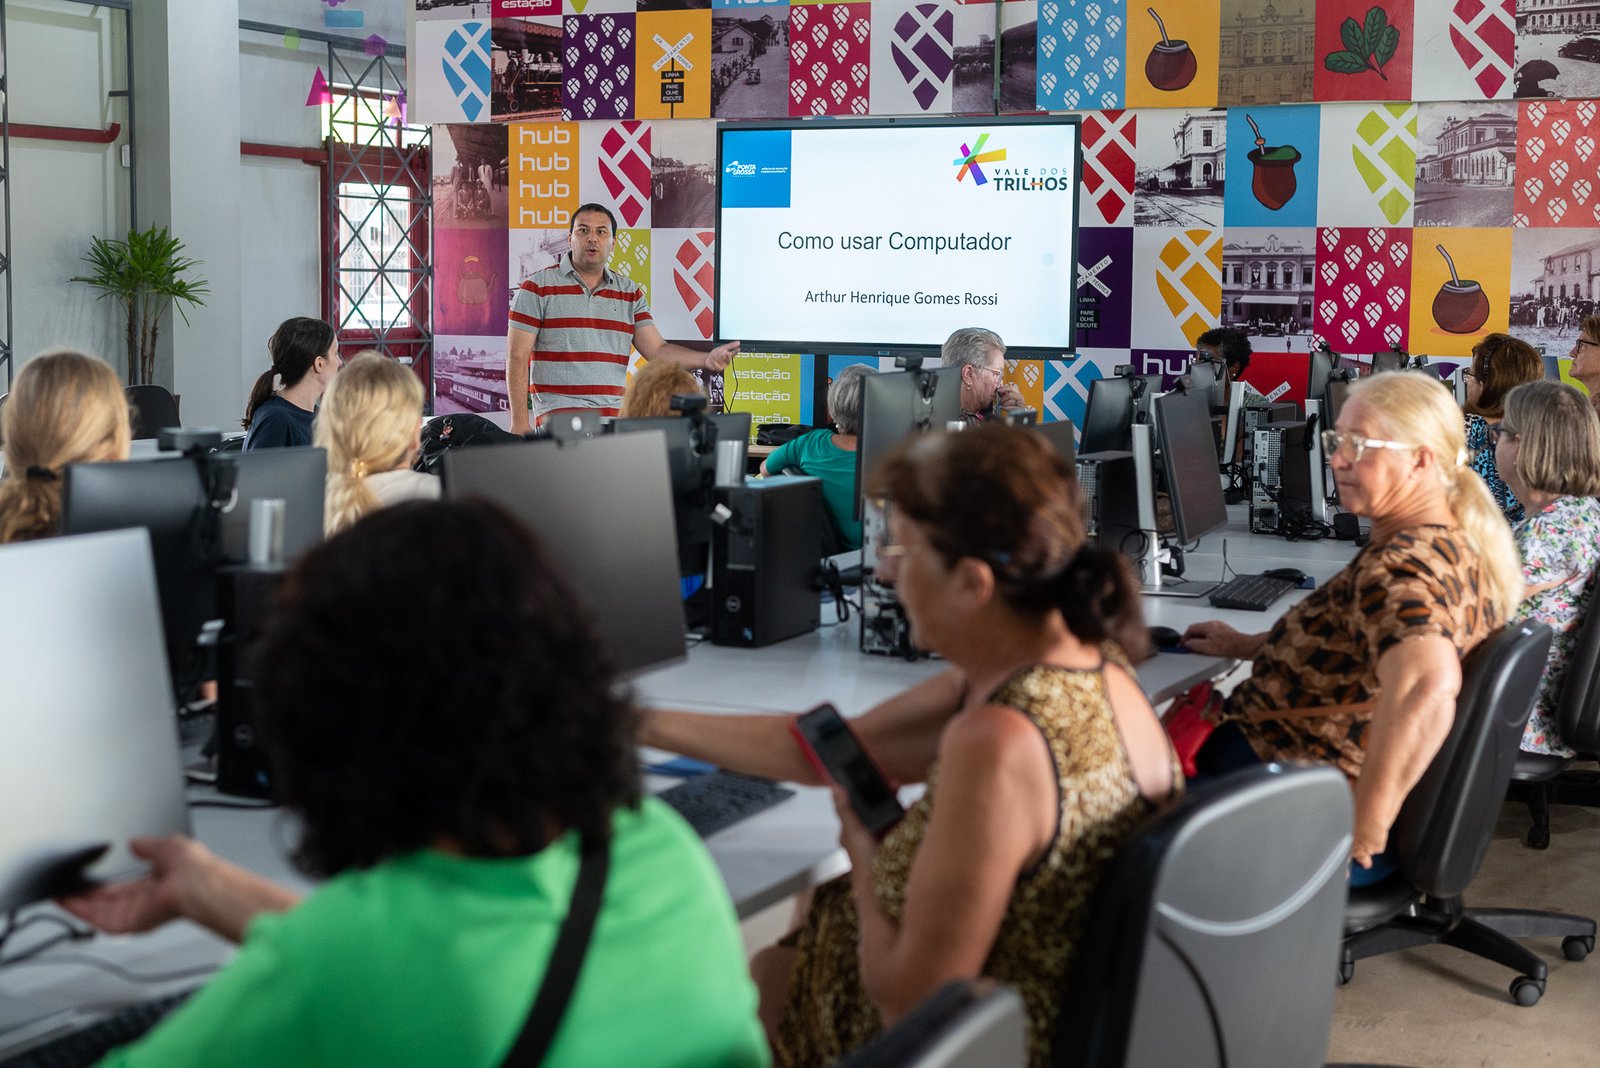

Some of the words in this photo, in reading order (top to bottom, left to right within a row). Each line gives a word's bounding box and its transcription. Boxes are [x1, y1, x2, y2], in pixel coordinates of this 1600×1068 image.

[656, 35, 691, 67] CRUZAMENTO
[519, 125, 570, 144] hub
[519, 152, 570, 171] hub
[519, 179, 570, 198] hub
[993, 177, 1068, 191] TRILHOS
[519, 205, 570, 225] hub
[778, 231, 834, 250] Como
[840, 235, 883, 250] usar
[888, 231, 1012, 254] Computador
[1077, 259, 1109, 286] UZAMENTO
[805, 290, 847, 303] Arthur
[850, 290, 910, 306] Henrique
[914, 291, 960, 305] Gomes
[964, 292, 998, 305] Rossi
[733, 369, 791, 382] estação
[733, 389, 791, 404] estação
[751, 412, 791, 424] tação
